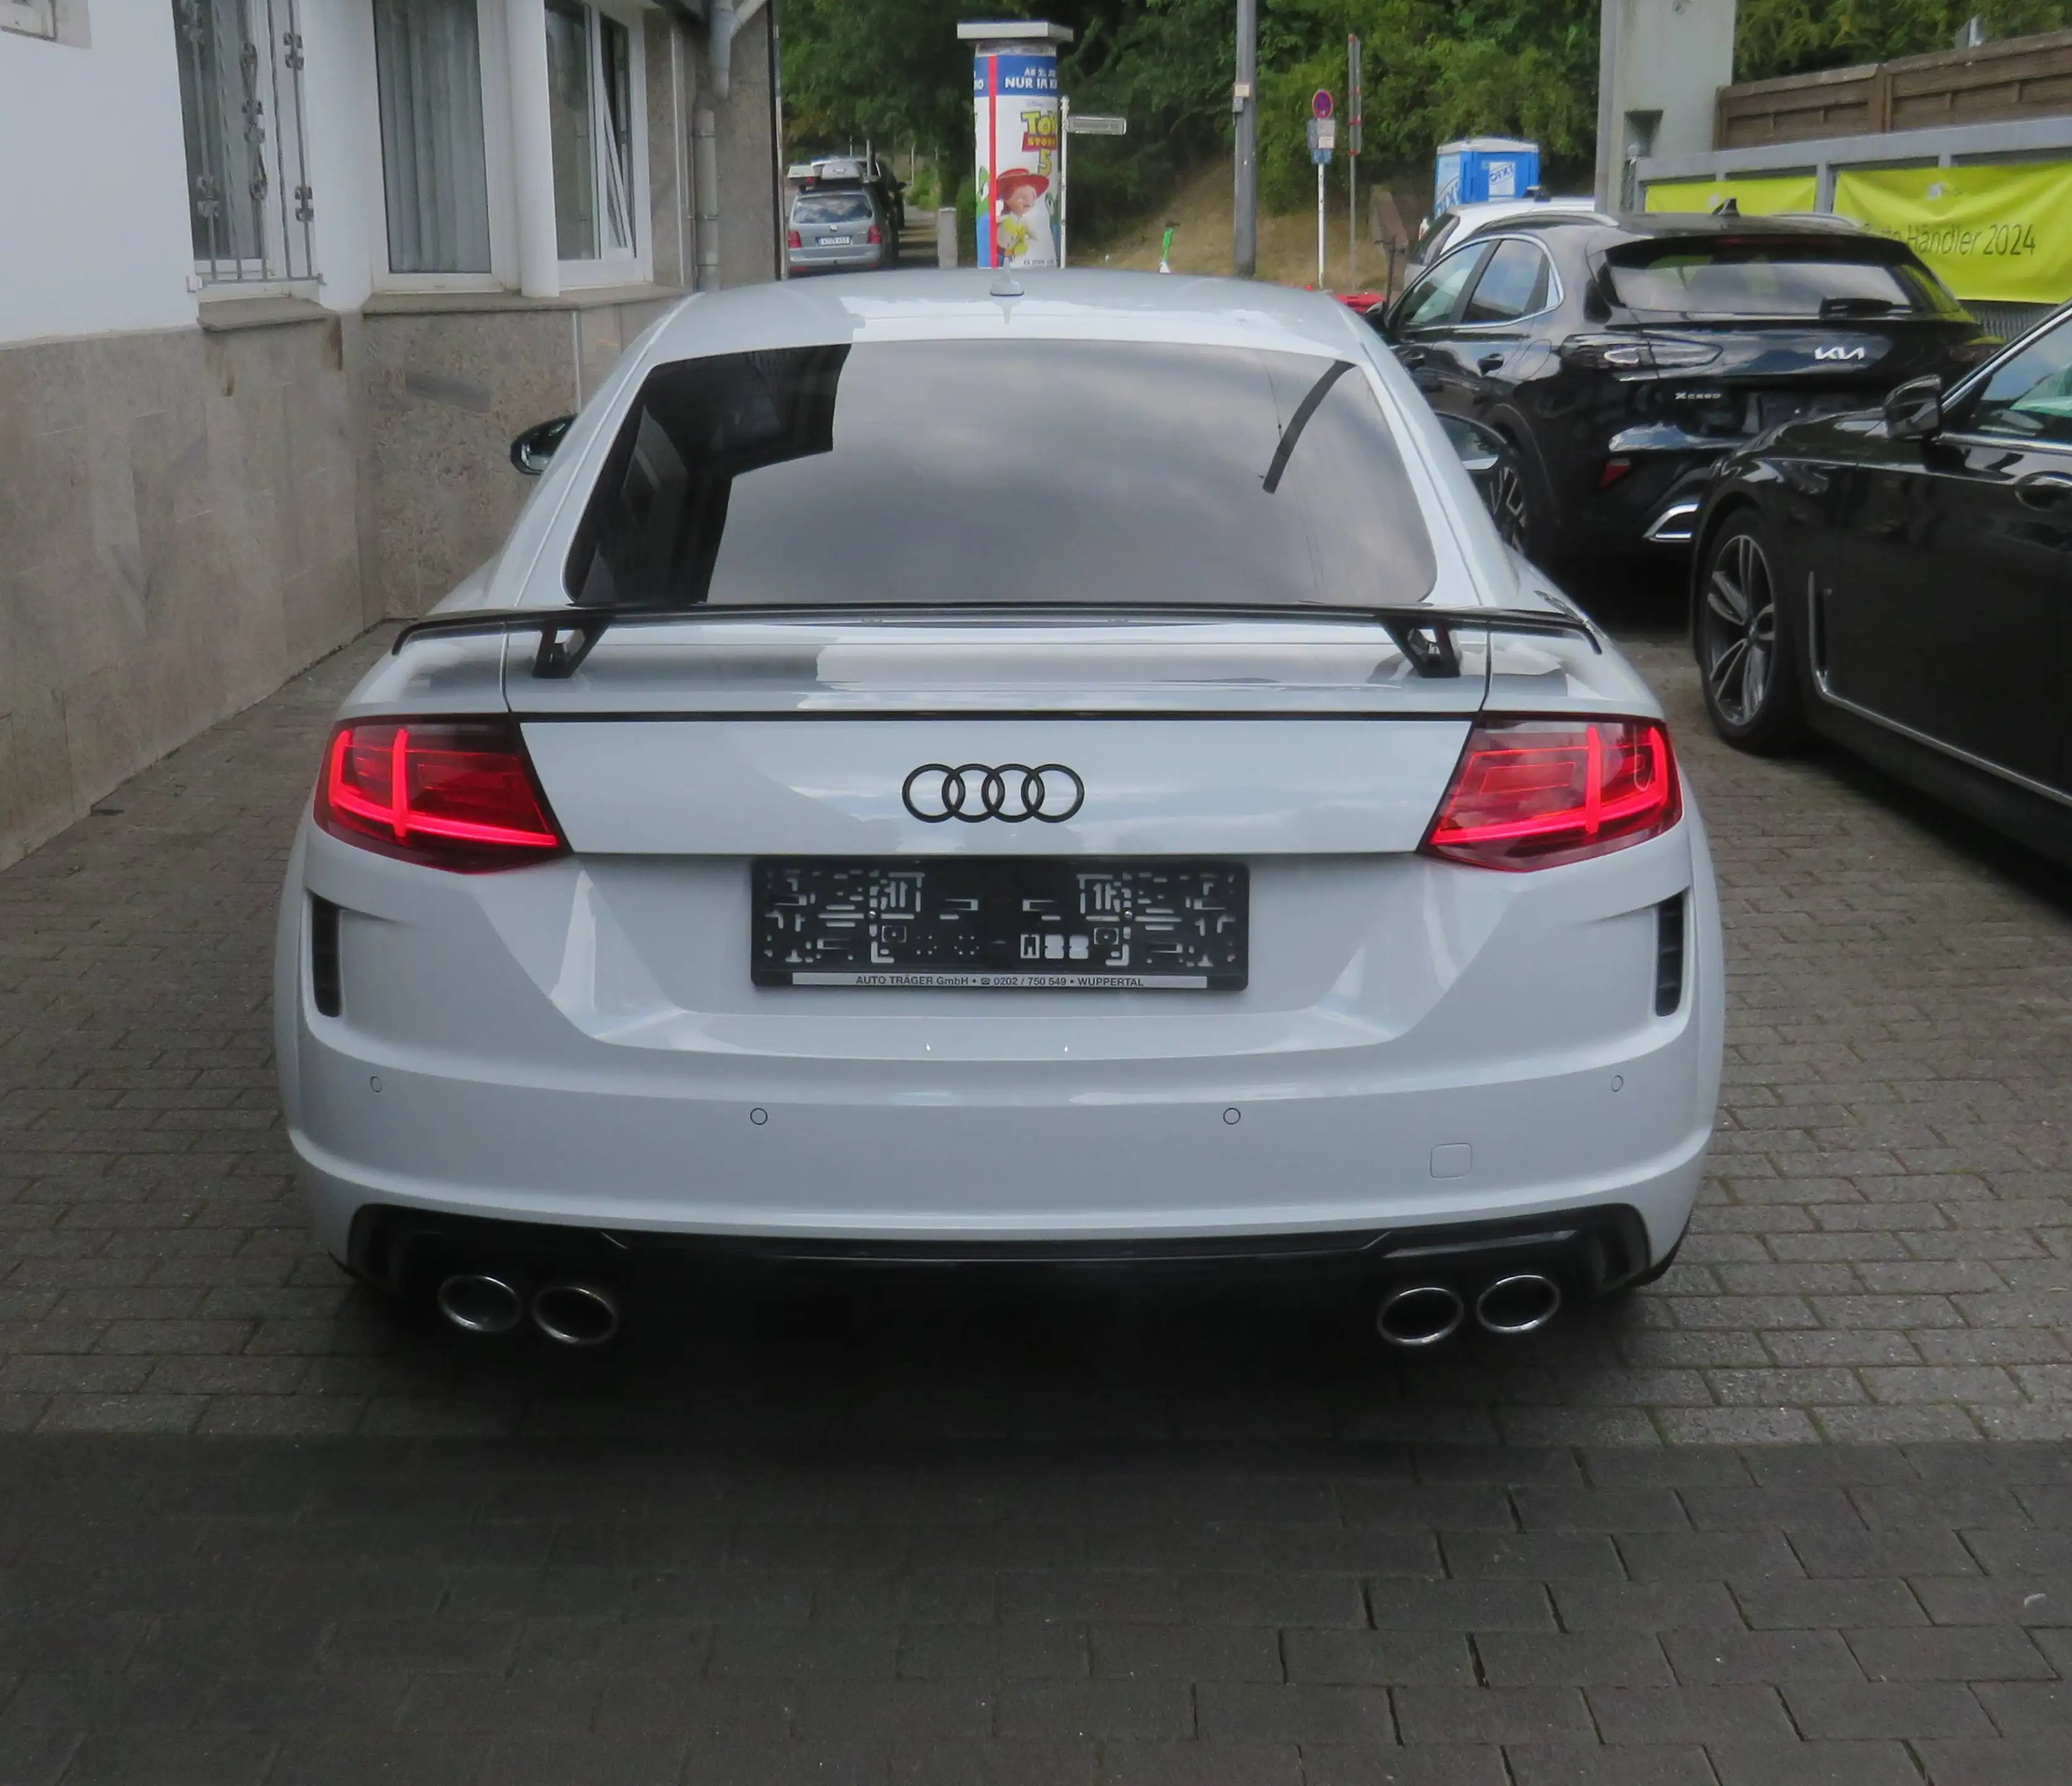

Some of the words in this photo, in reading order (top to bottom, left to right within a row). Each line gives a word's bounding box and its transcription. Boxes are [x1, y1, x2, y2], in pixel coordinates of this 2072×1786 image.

[1005, 77, 1033, 88] NUR
[1038, 148, 1052, 176] 5
[1908, 224, 1982, 255] Händler
[1983, 223, 2036, 256] 2024
[1814, 347, 1865, 360] KIA
[856, 976, 887, 985] AUTO
[889, 974, 933, 985] TRÄGER
[936, 976, 968, 985] GmbH
[993, 977, 1018, 985] 0202
[1028, 977, 1045, 985] 750
[1048, 977, 1066, 986] 549
[1078, 977, 1144, 987] WUPPERTAL
